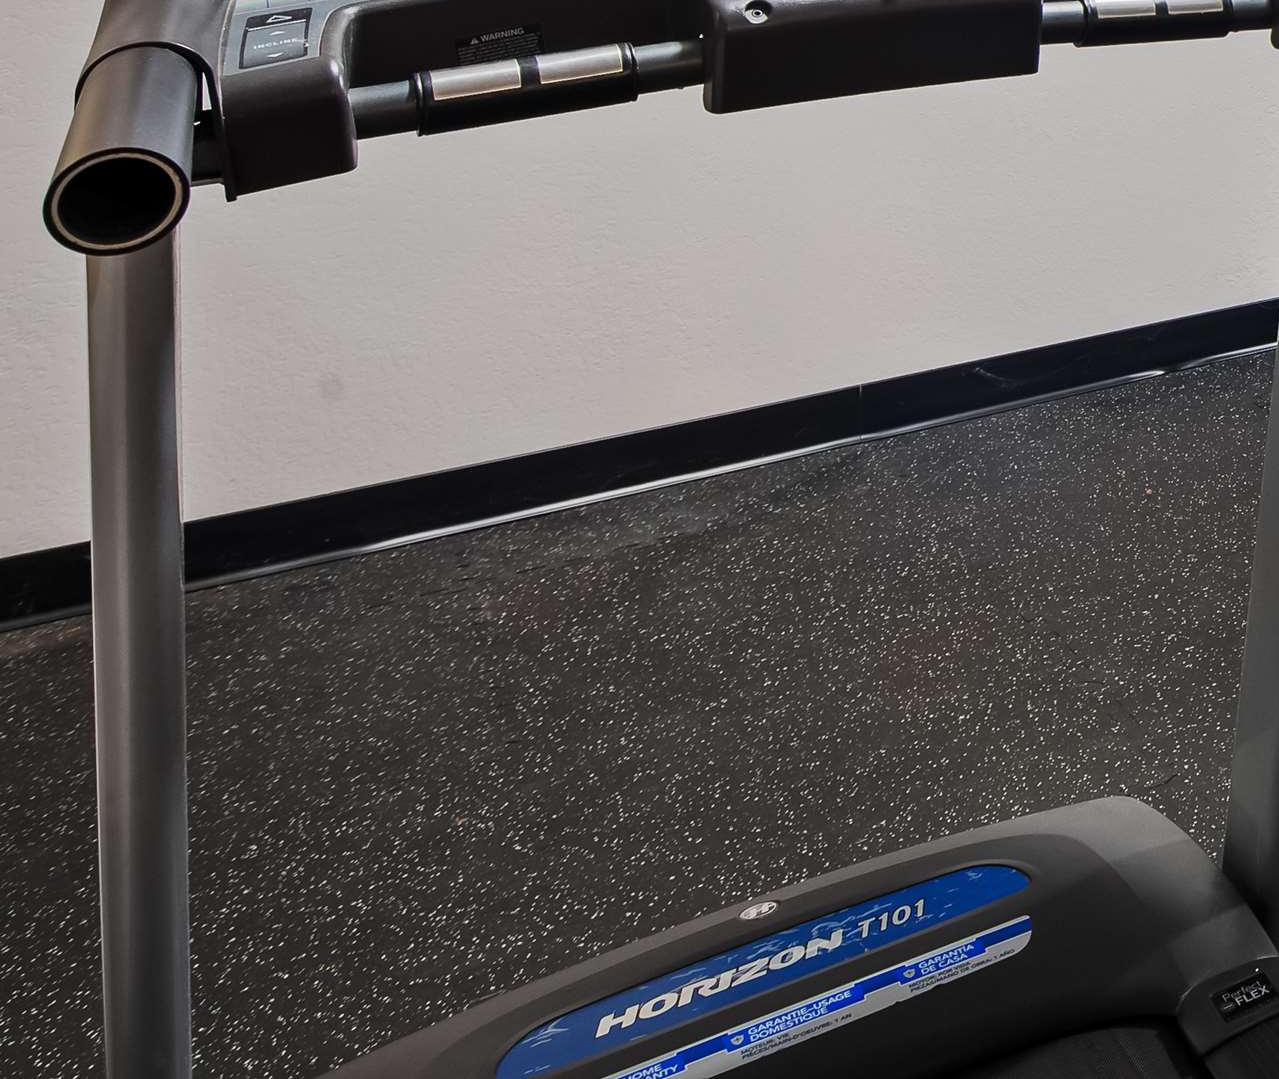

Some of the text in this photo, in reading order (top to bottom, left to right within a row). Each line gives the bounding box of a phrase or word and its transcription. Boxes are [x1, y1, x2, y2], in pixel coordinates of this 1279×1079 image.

[480, 27, 525, 41] WARNING
[918, 943, 975, 969] GARANTÍA
[920, 953, 969, 976] DE CASA
[594, 898, 926, 1039] HORIZON T101
[1235, 985, 1270, 1006] FLEX
[750, 1007, 830, 1042] DOMESTIQUE
